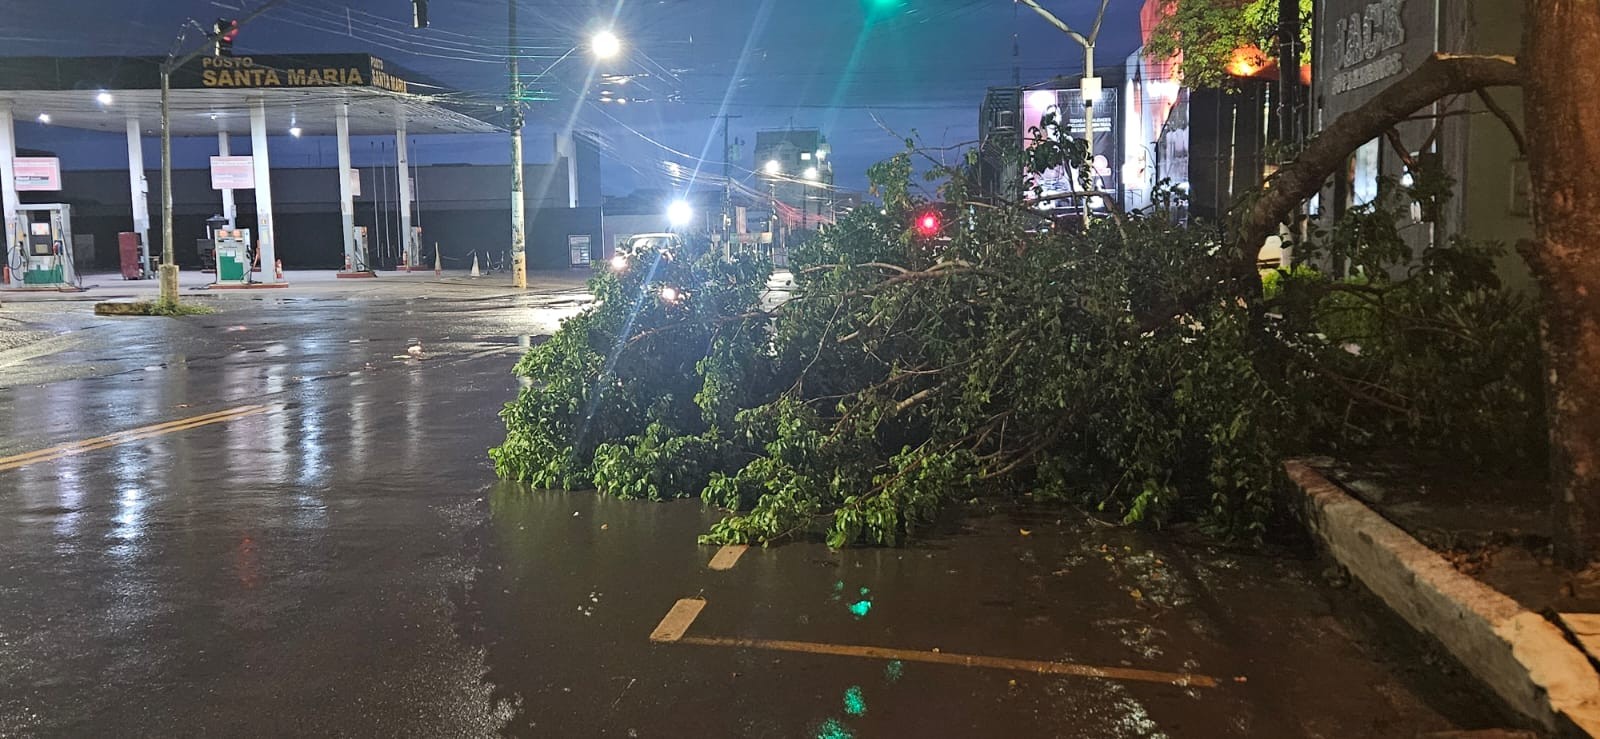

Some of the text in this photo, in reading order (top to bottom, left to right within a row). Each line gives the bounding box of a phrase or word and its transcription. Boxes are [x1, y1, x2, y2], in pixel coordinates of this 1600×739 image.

[1332, 0, 1404, 69] JACK
[202, 56, 253, 68] POSTO
[202, 67, 363, 87] SANTA MARIA
